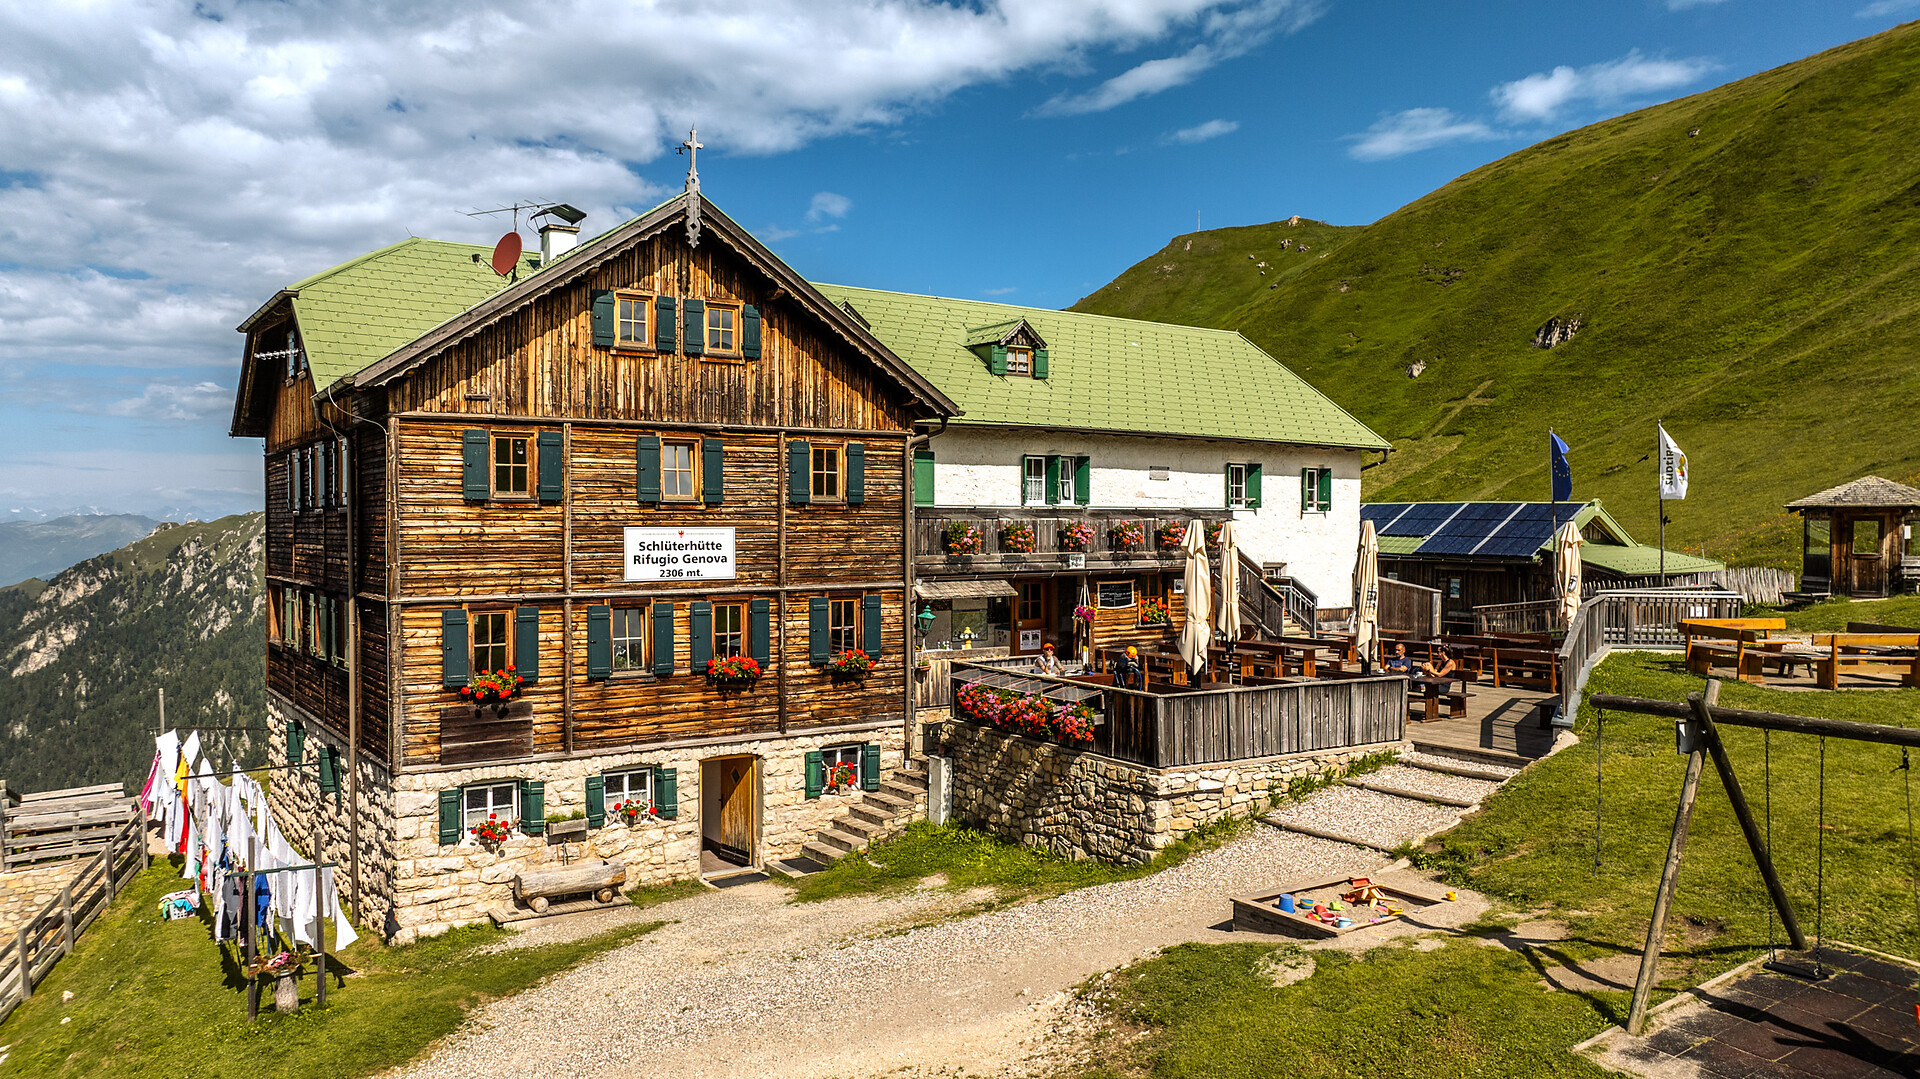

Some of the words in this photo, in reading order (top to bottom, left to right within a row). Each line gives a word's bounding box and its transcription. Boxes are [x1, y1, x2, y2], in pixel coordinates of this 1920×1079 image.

[639, 541, 722, 551] Schlüterhütte
[634, 554, 678, 566] Rifugio
[683, 554, 727, 563] Genova
[660, 569, 683, 577] 2306
